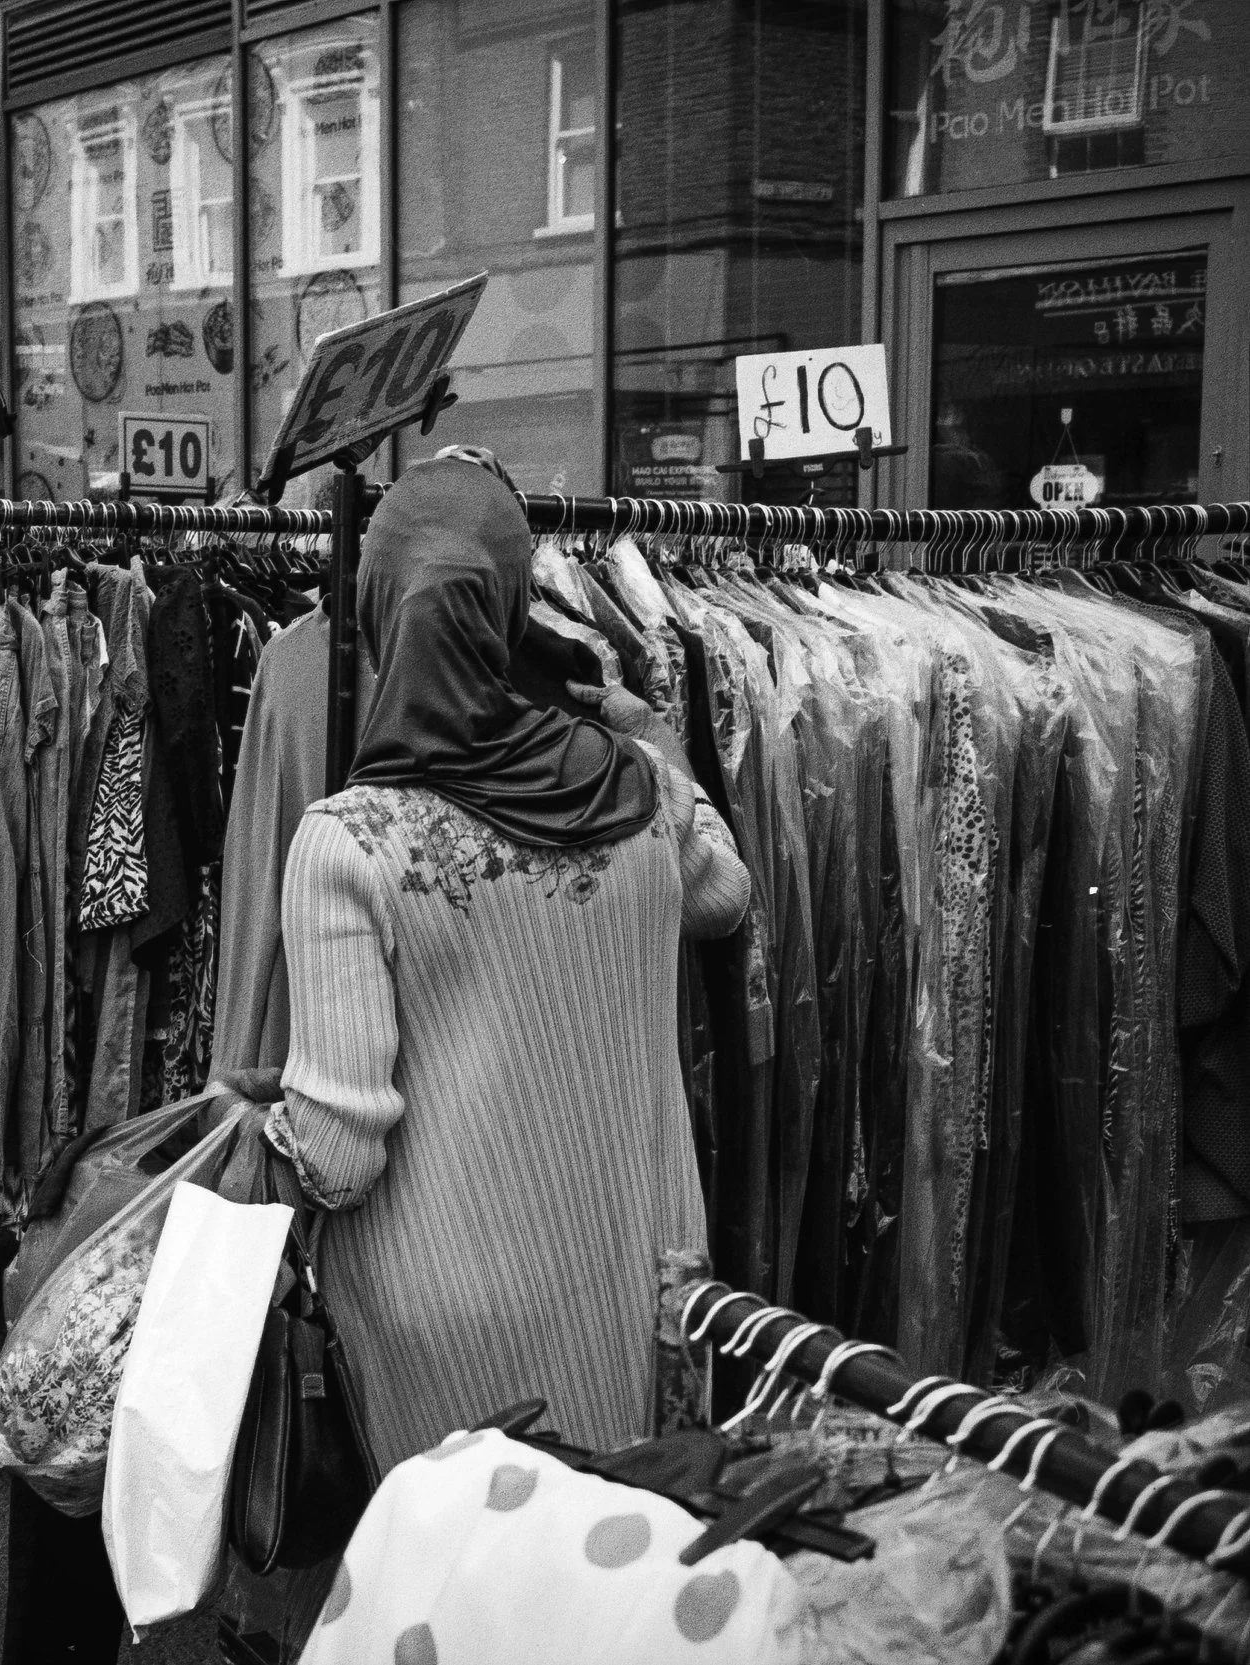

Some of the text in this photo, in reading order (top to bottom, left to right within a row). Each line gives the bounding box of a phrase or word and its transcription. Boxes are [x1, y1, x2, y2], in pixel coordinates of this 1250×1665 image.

[930, 111, 989, 144] Pao
[997, 98, 1070, 132] Men
[1150, 74, 1211, 110] Pot
[296, 309, 455, 445] £10
[754, 361, 865, 439] £10
[132, 428, 202, 479] £10
[1042, 481, 1085, 502] OPEN
